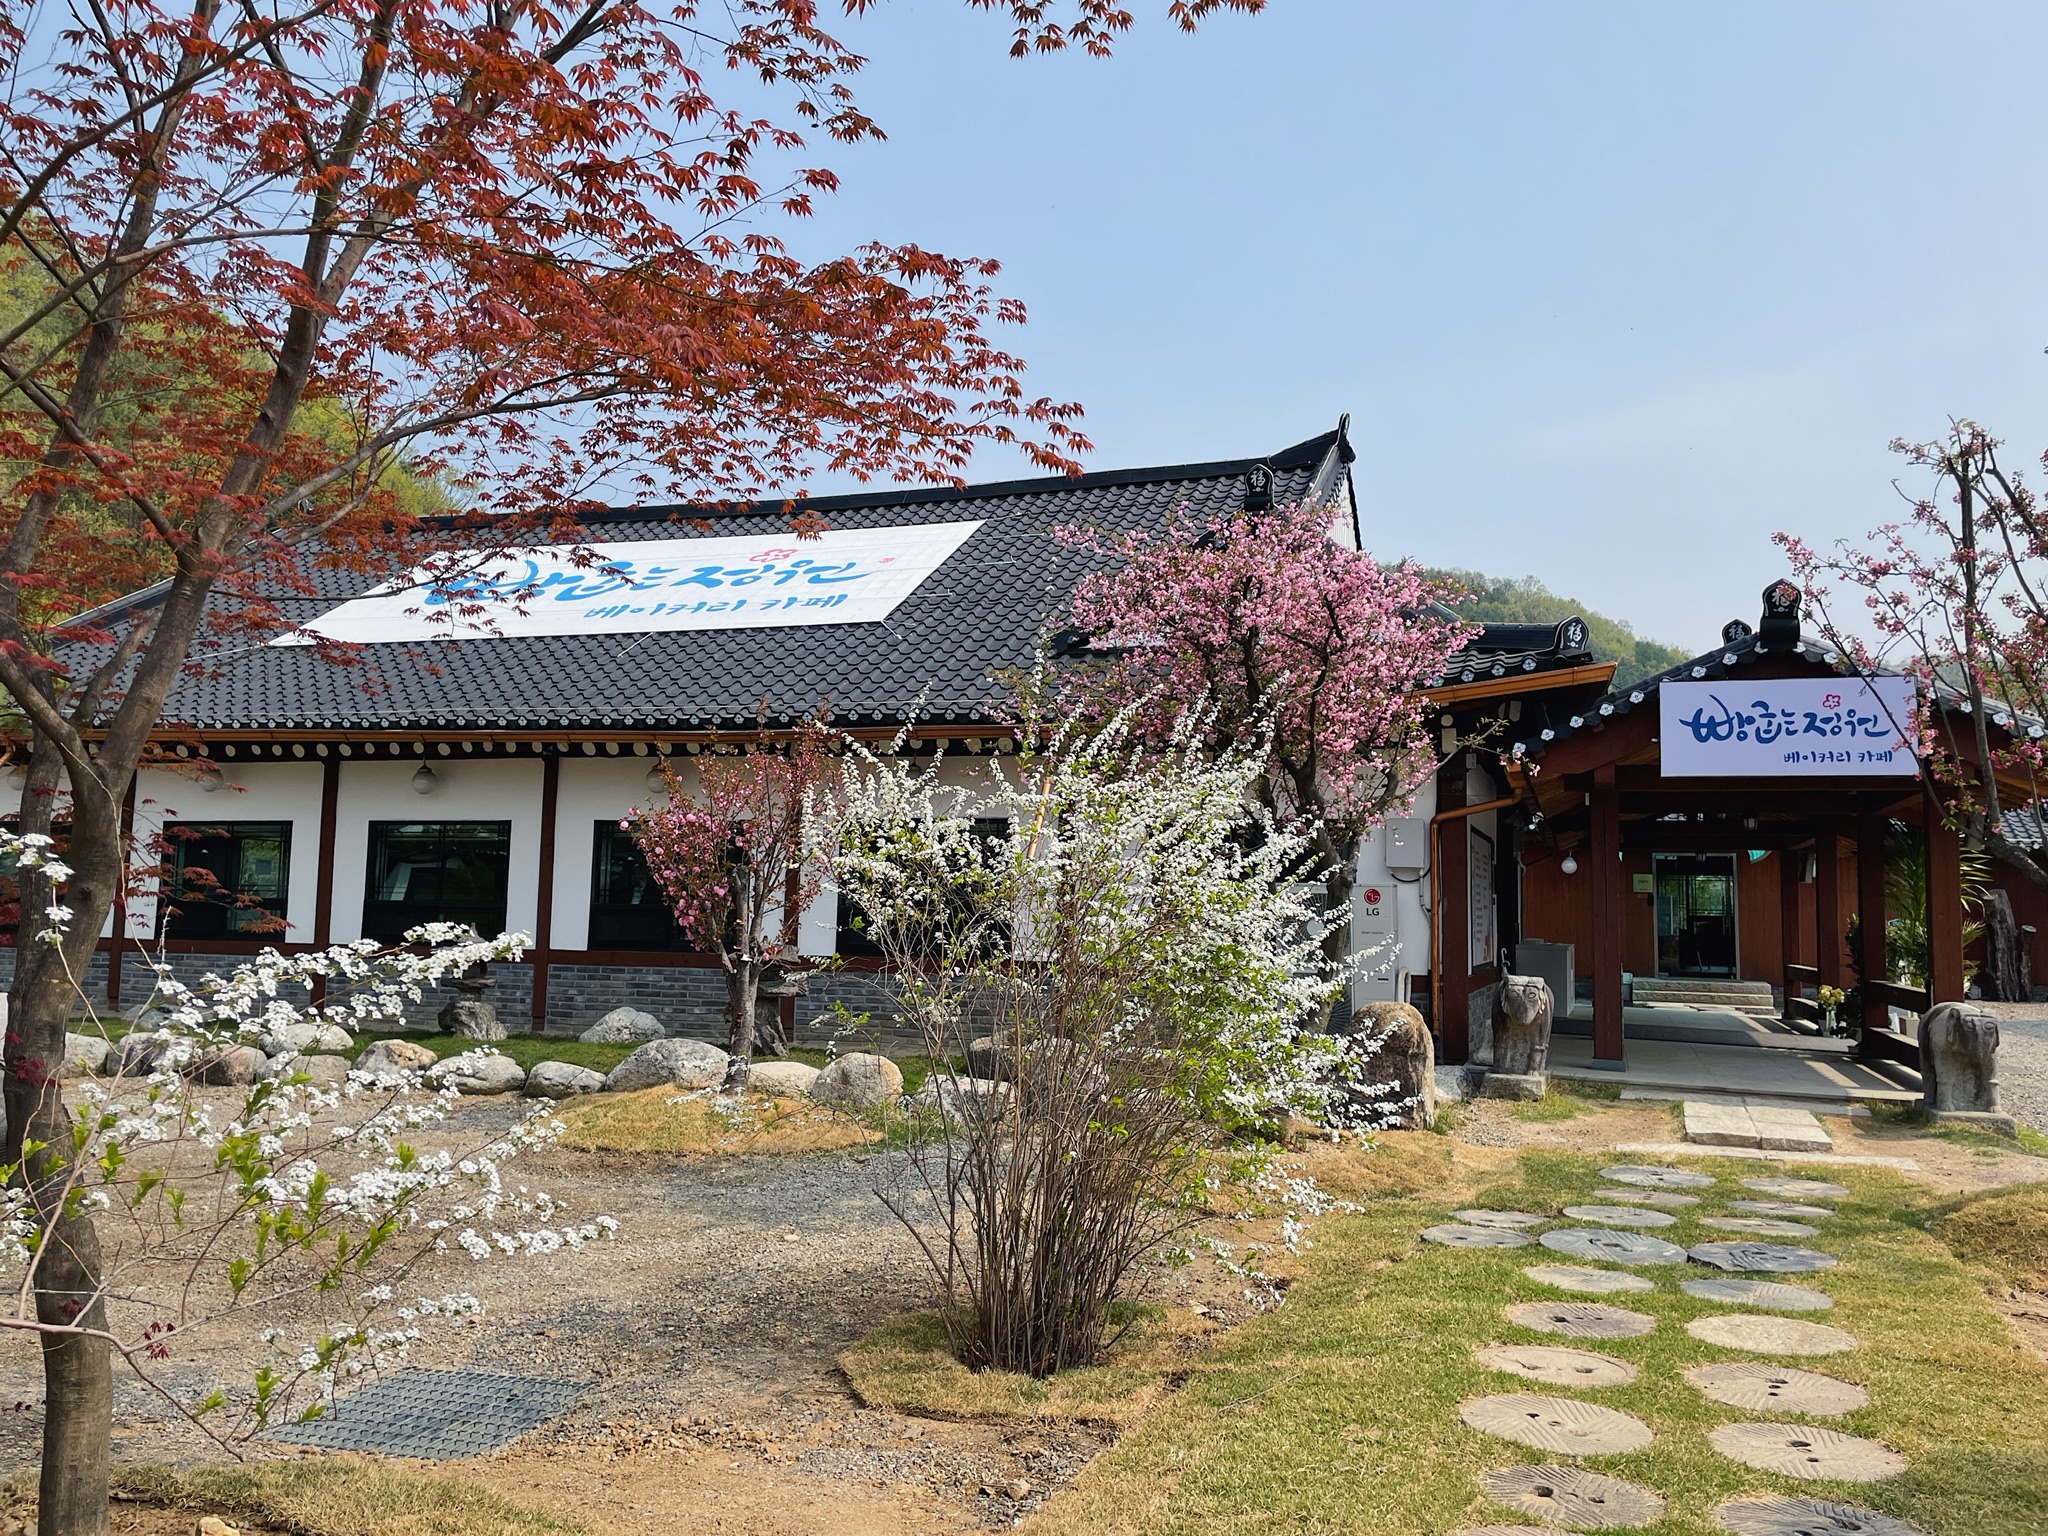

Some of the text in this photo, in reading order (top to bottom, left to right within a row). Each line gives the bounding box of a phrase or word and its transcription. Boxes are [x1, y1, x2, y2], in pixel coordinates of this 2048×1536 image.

[584, 593, 849, 619] 베이커리 카페
[1783, 750, 1893, 764] 베이커리 카페
[1366, 907, 1380, 916] LG
